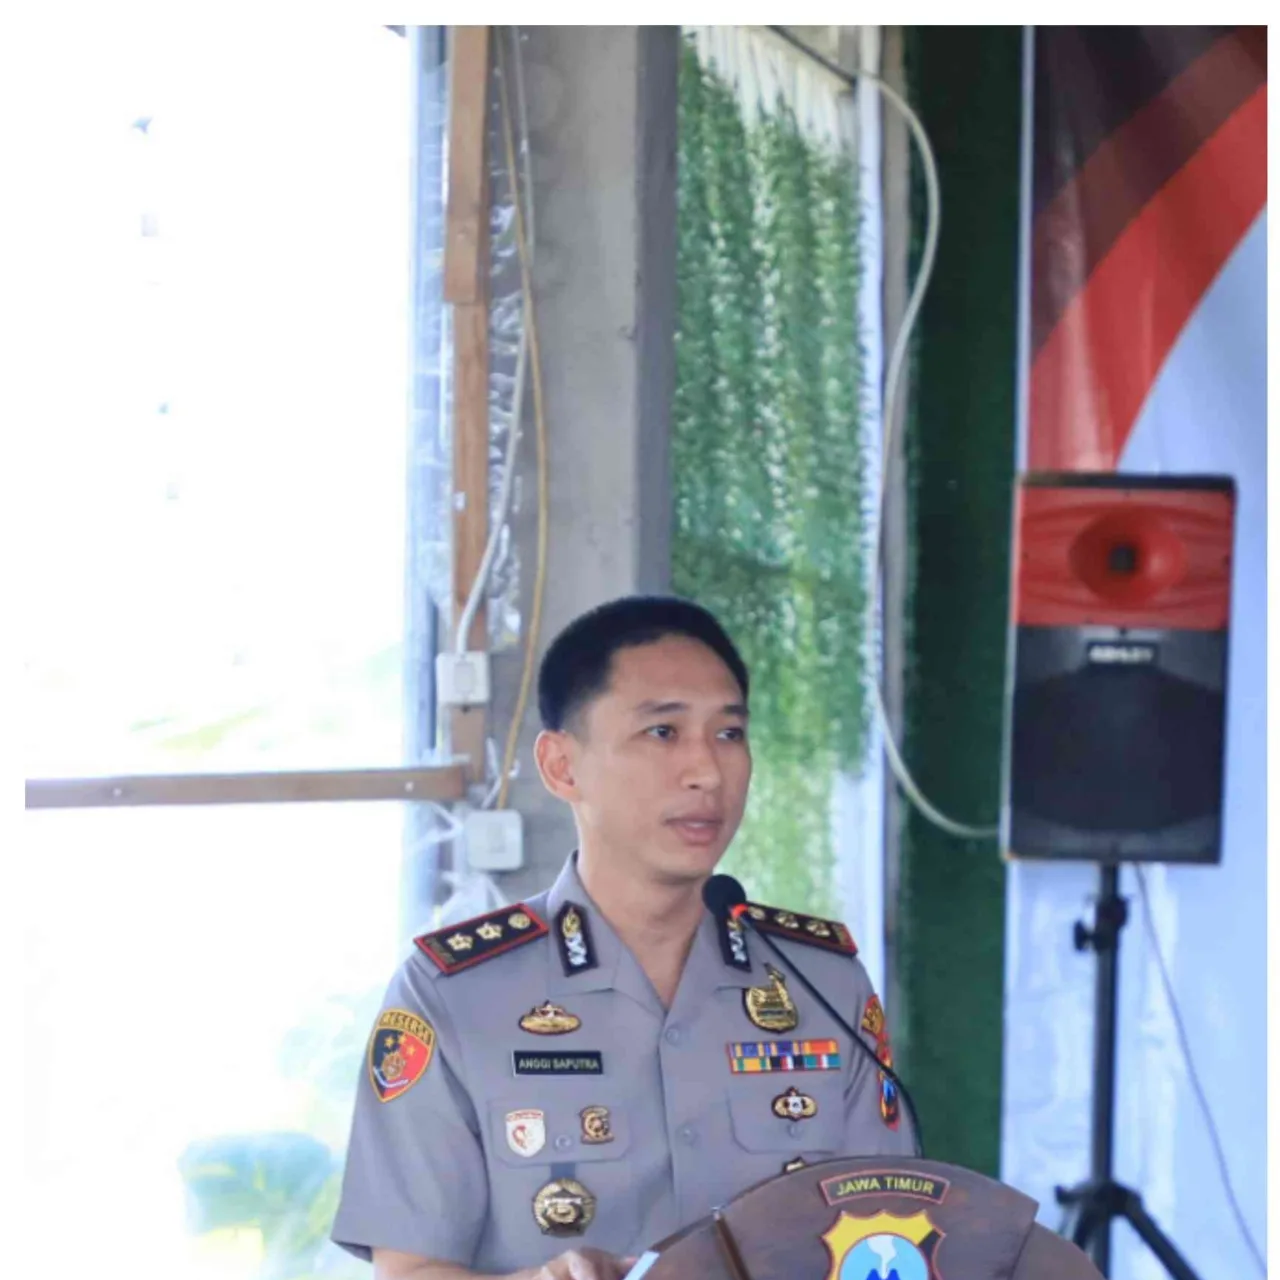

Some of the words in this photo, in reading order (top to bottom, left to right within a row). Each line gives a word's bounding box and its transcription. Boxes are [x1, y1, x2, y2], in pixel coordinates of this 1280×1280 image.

[518, 1058, 551, 1070] ANGGI
[553, 1058, 599, 1070] SAPUTRA
[836, 1177, 881, 1196] JAWA
[884, 1176, 935, 1195] TIMUR
